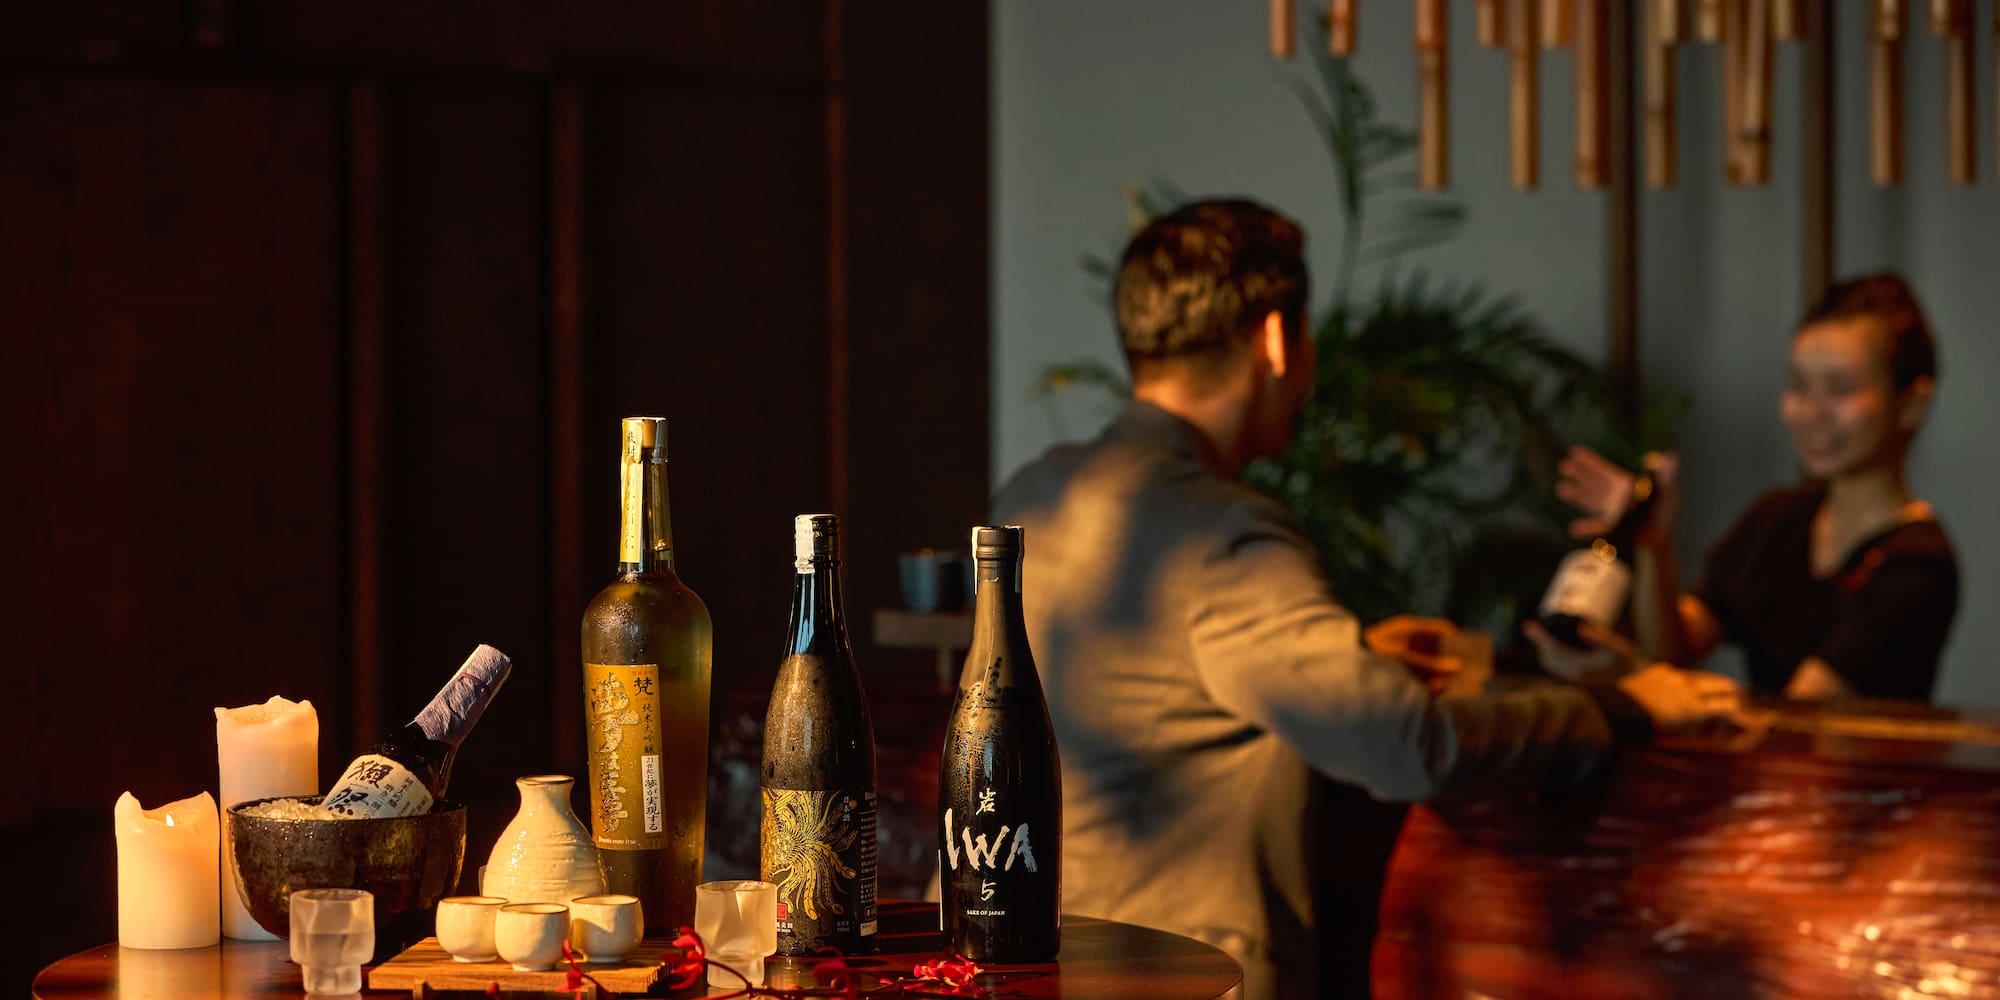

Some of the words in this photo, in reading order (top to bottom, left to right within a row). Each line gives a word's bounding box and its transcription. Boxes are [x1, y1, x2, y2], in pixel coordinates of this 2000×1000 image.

[633, 676, 654, 696] 梵
[975, 787, 997, 816] 岩
[944, 807, 1038, 872] IWA
[980, 879, 997, 901] 5
[988, 909, 1005, 917] JAPAN
